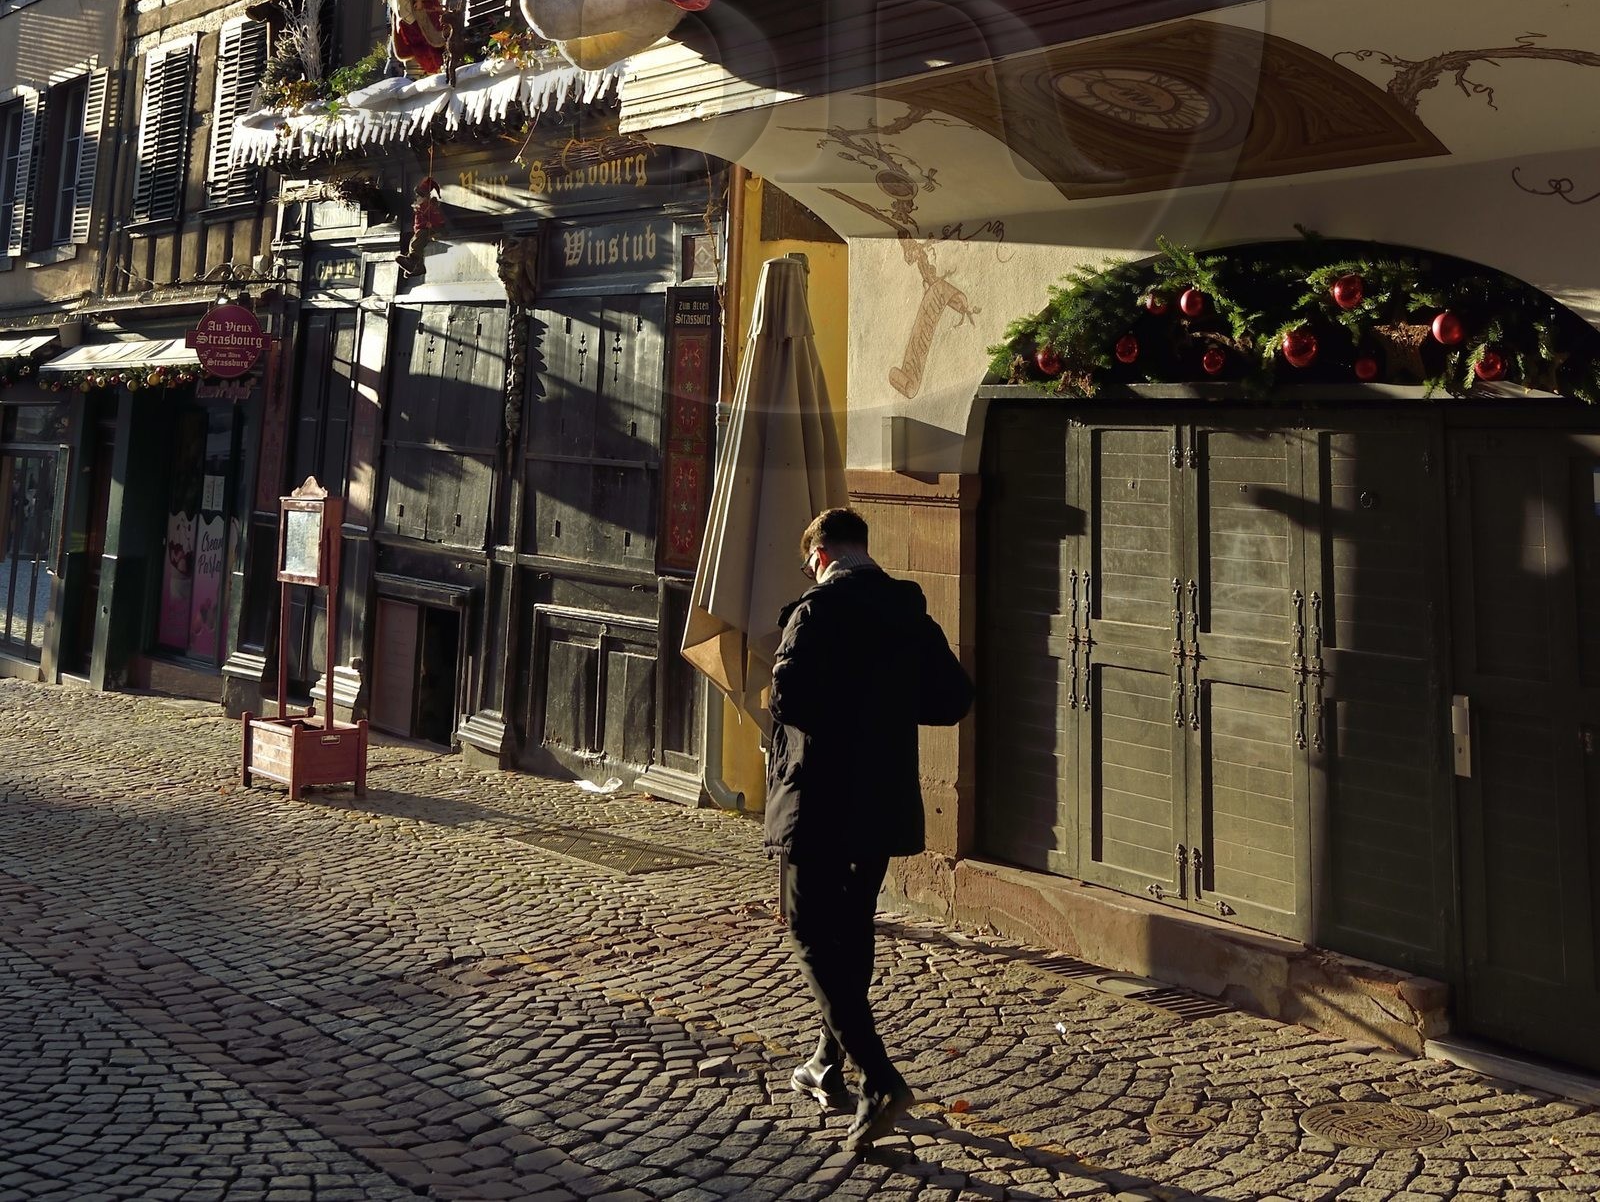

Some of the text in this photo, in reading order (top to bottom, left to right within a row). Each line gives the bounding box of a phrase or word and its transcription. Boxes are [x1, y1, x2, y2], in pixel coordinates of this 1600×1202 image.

[563, 223, 656, 267] Winstub
[207, 320, 253, 333] Au Vieux
[196, 332, 263, 348] Strasbourg
[206, 358, 249, 368] Strassburg
